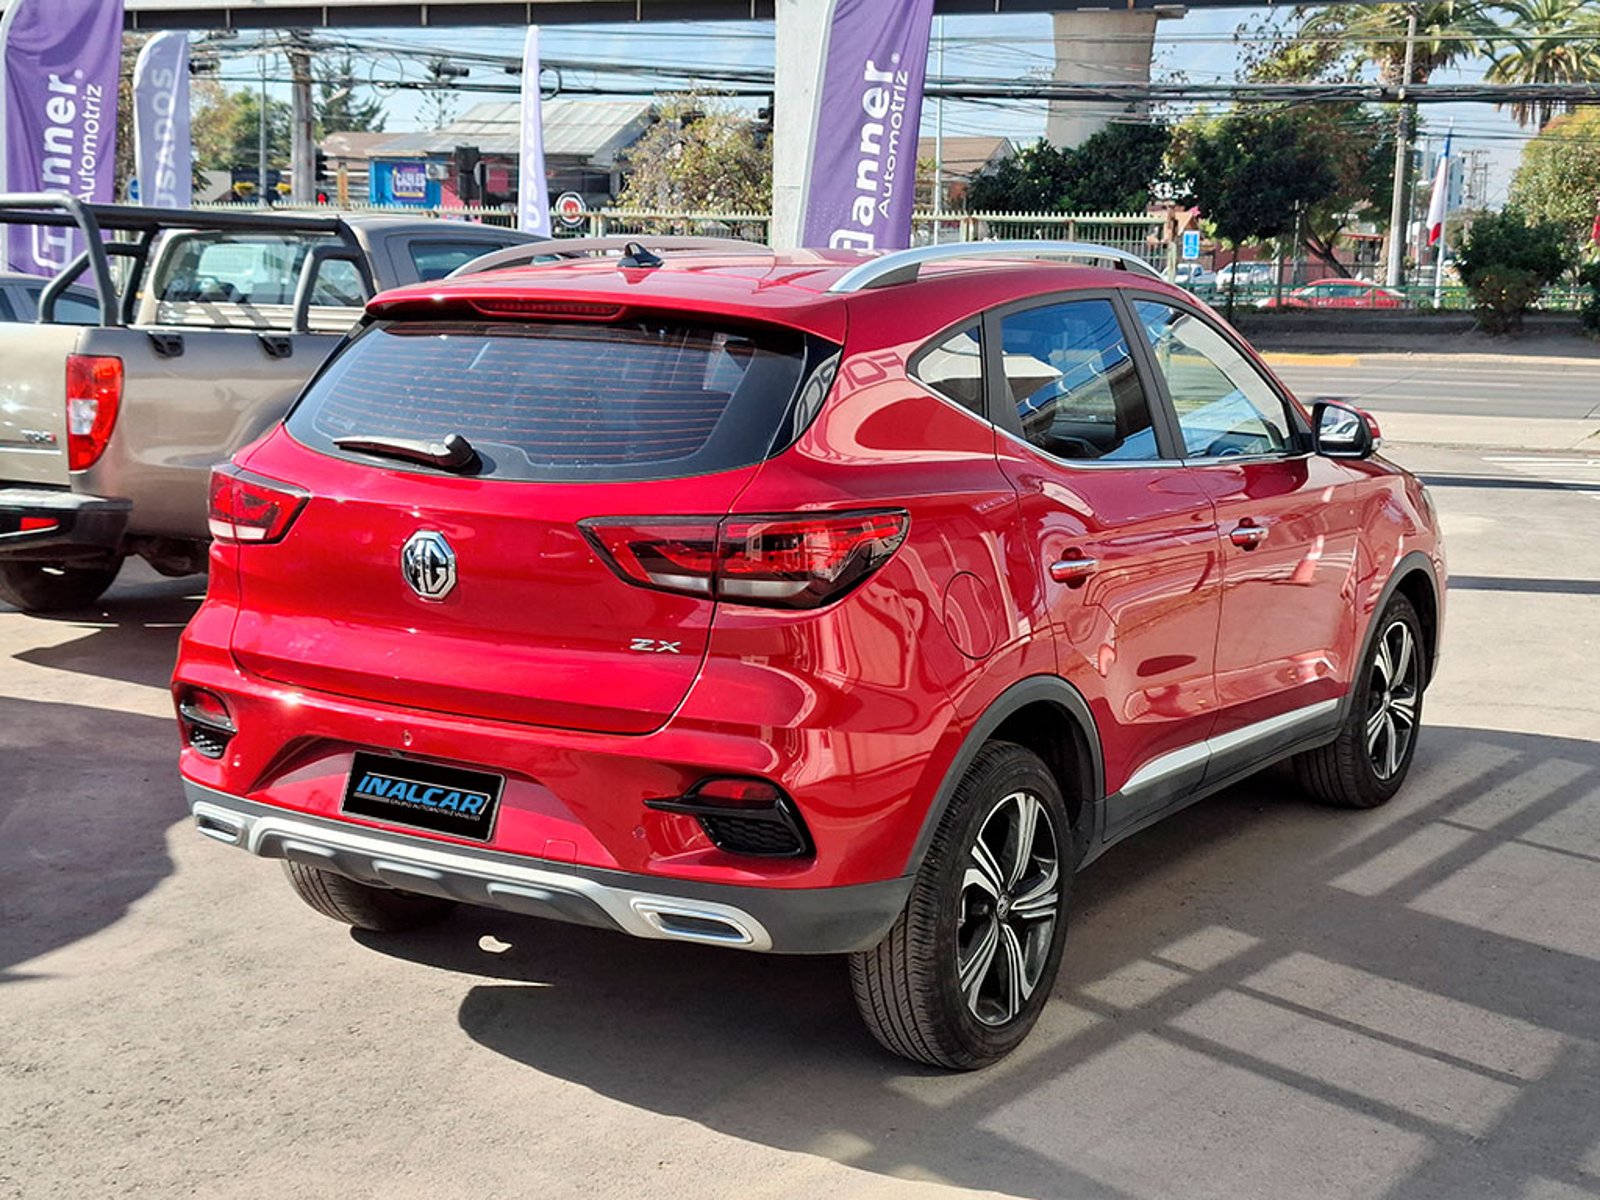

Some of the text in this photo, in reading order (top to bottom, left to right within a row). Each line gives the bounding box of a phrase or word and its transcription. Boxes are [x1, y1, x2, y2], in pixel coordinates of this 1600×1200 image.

[77, 83, 103, 204] Automotriz
[877, 70, 909, 219] Automotriz
[404, 537, 449, 595] MG
[629, 638, 681, 653] ZX
